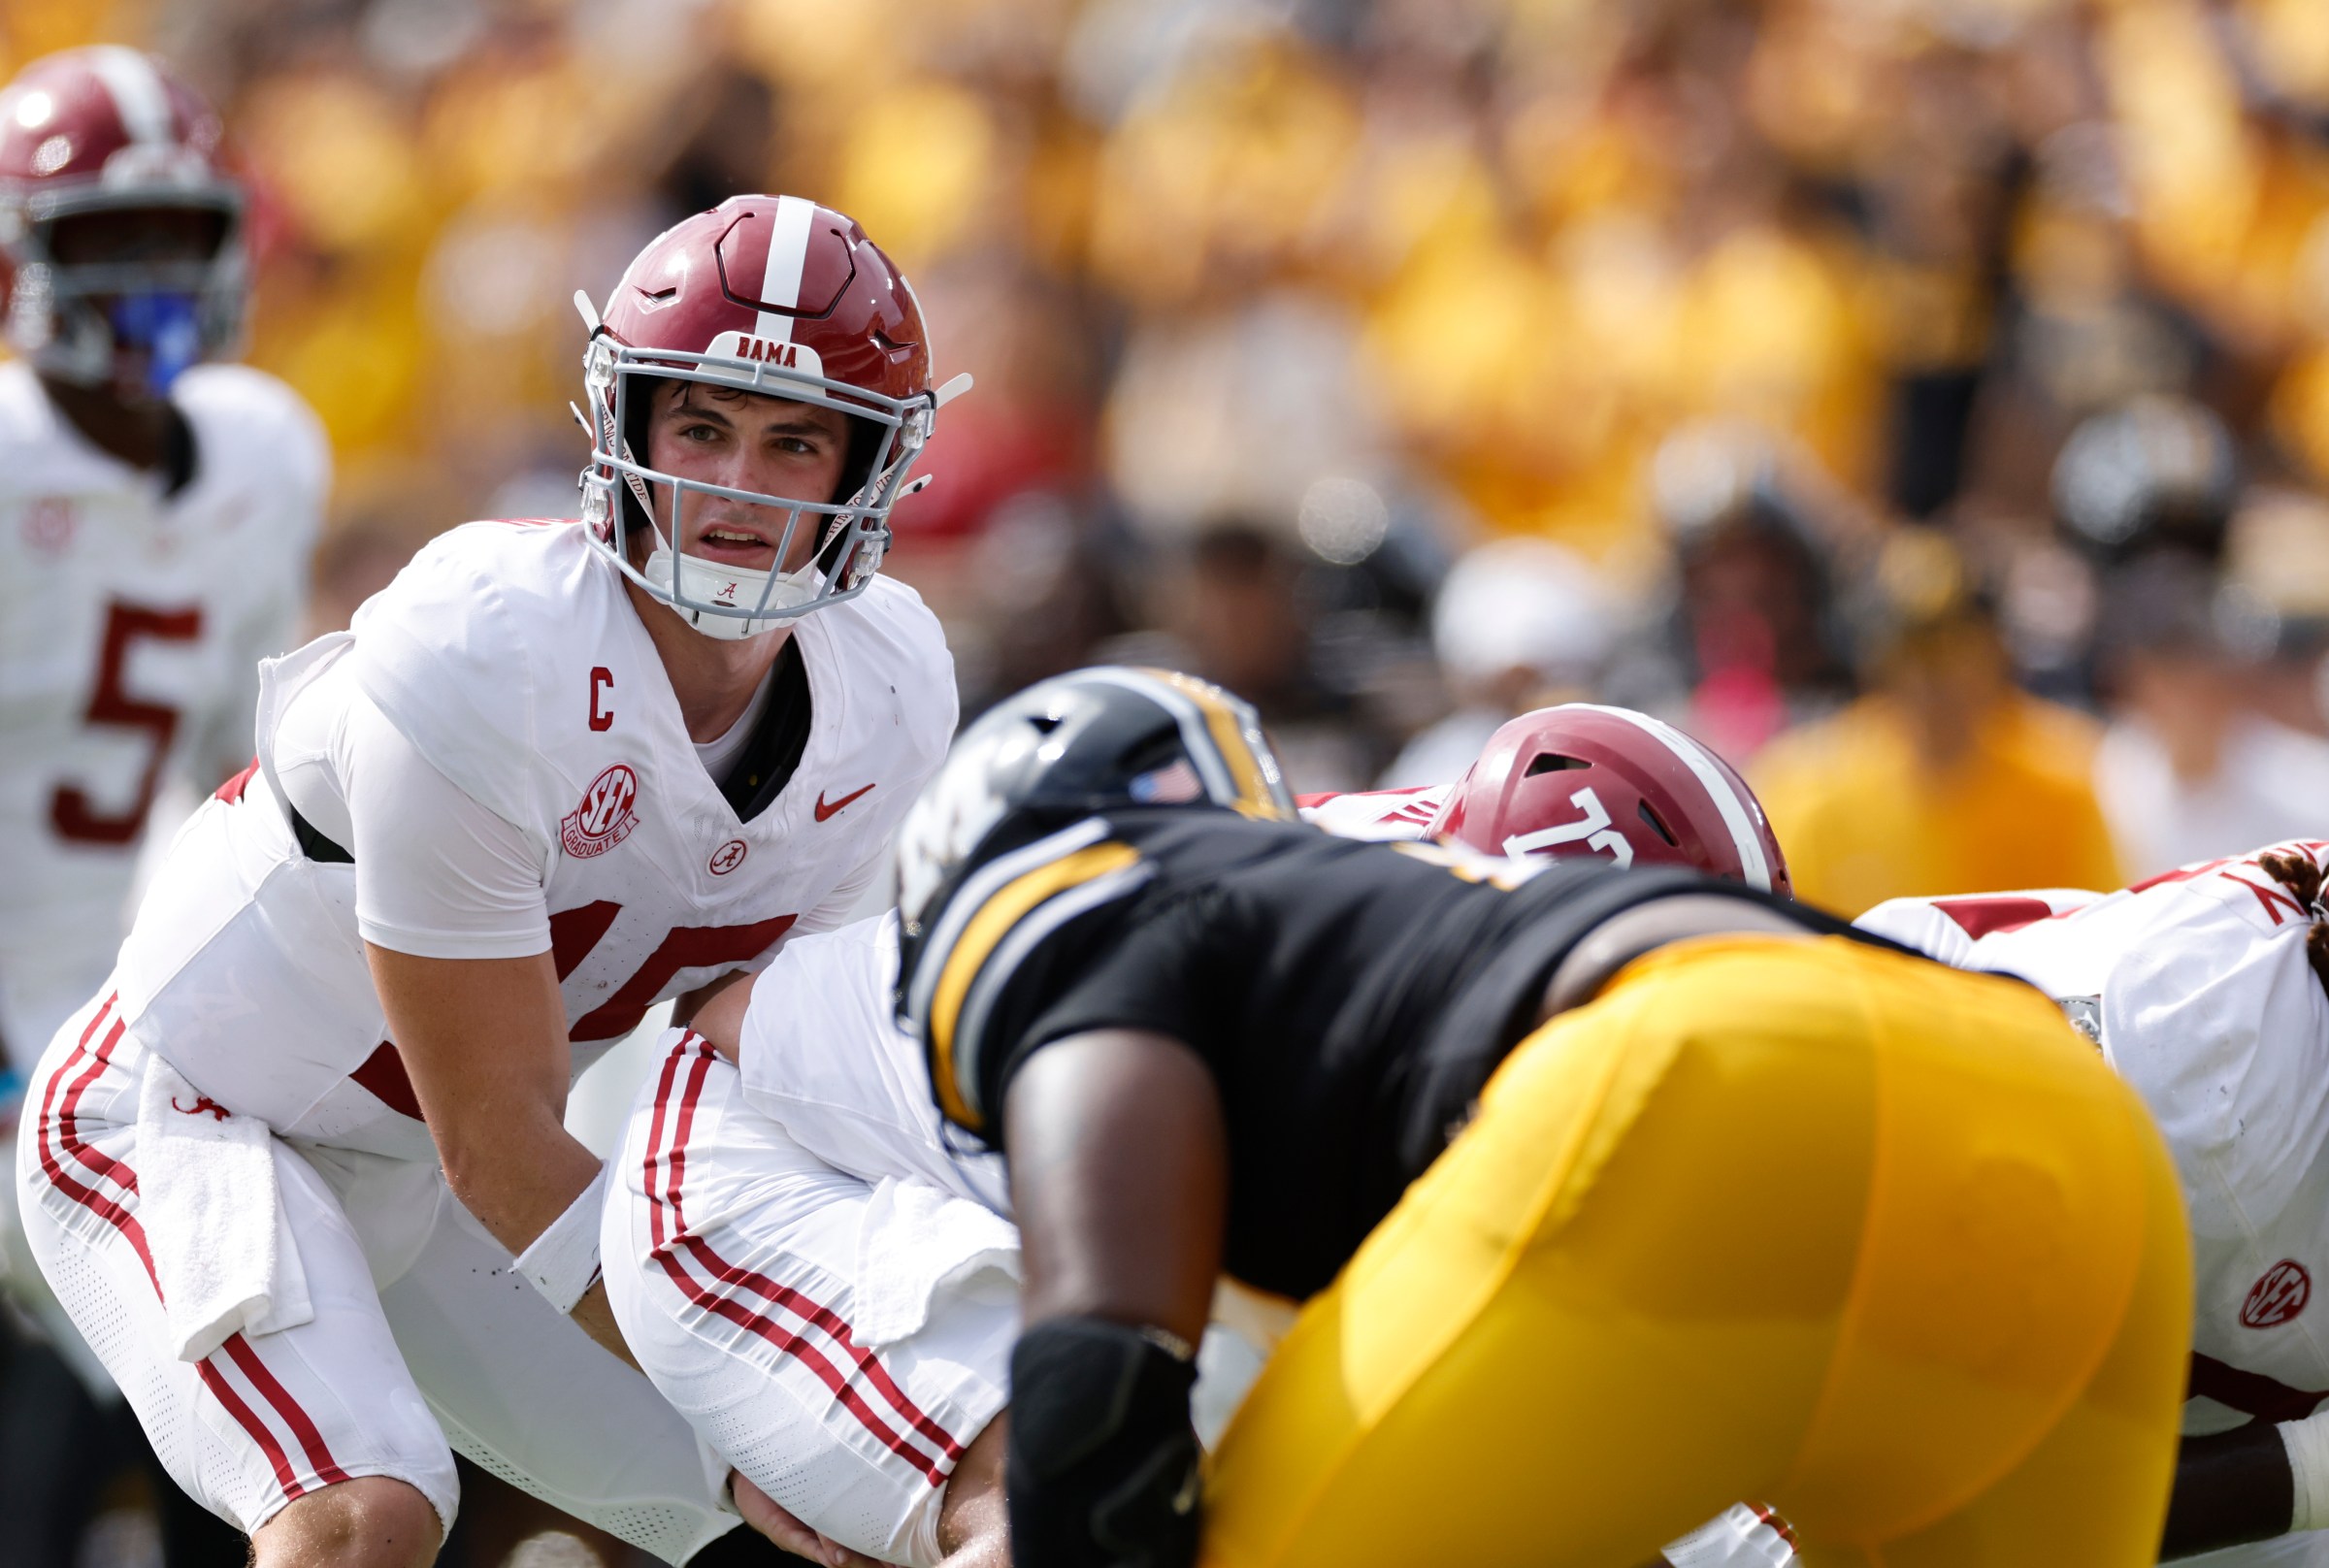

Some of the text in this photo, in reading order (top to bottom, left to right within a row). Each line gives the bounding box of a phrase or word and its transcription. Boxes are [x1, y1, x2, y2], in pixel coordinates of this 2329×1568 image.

[737, 336, 797, 368] BAMA
[50, 598, 204, 846] 5
[589, 667, 613, 732] C
[580, 768, 636, 834] SEC
[566, 830, 621, 856] GRADUATE
[2245, 1265, 2306, 1324] SEC
